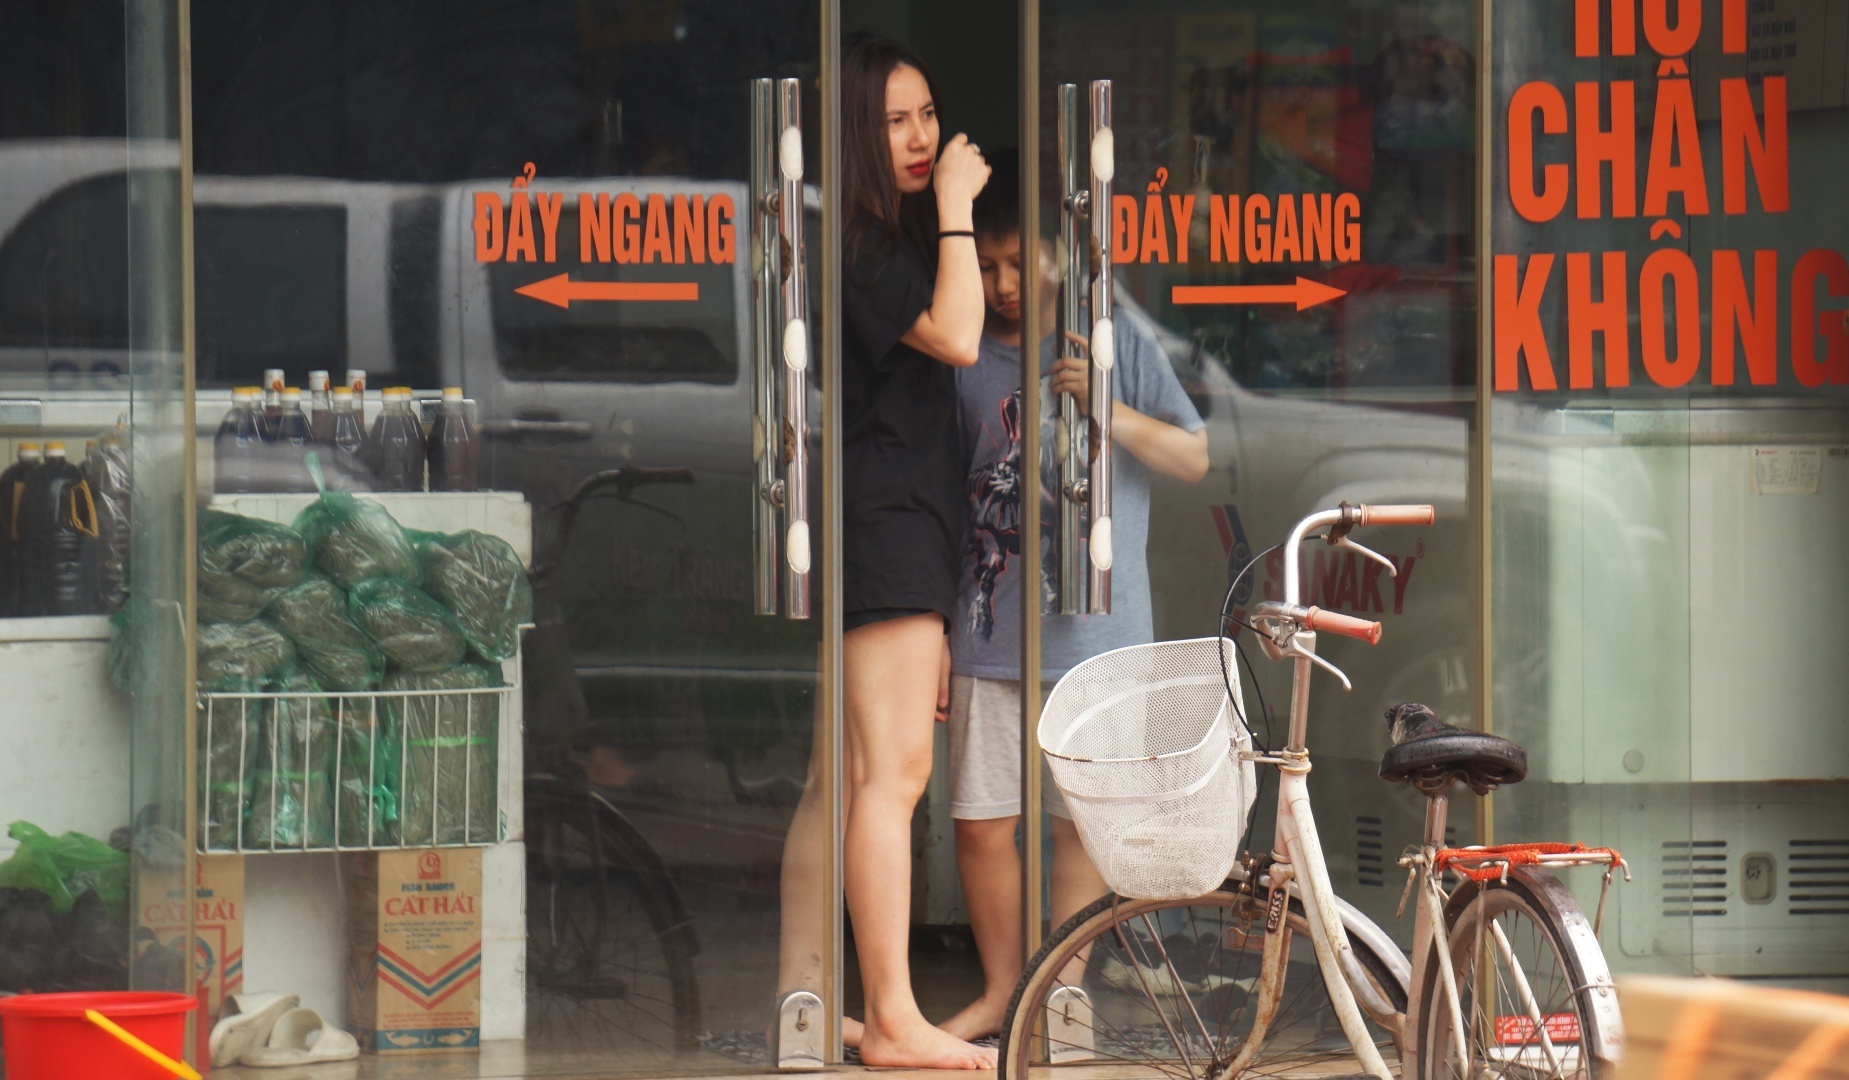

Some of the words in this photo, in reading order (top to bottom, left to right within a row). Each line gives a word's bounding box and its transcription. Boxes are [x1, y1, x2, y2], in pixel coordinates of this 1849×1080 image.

[1508, 57, 1789, 224] CHÂN
[473, 161, 562, 263] ĐẨY
[579, 193, 735, 264] NGANG
[1111, 167, 1197, 264] ĐẨY
[1210, 192, 1361, 264] NGANG
[1494, 218, 1849, 391] KHÔNG
